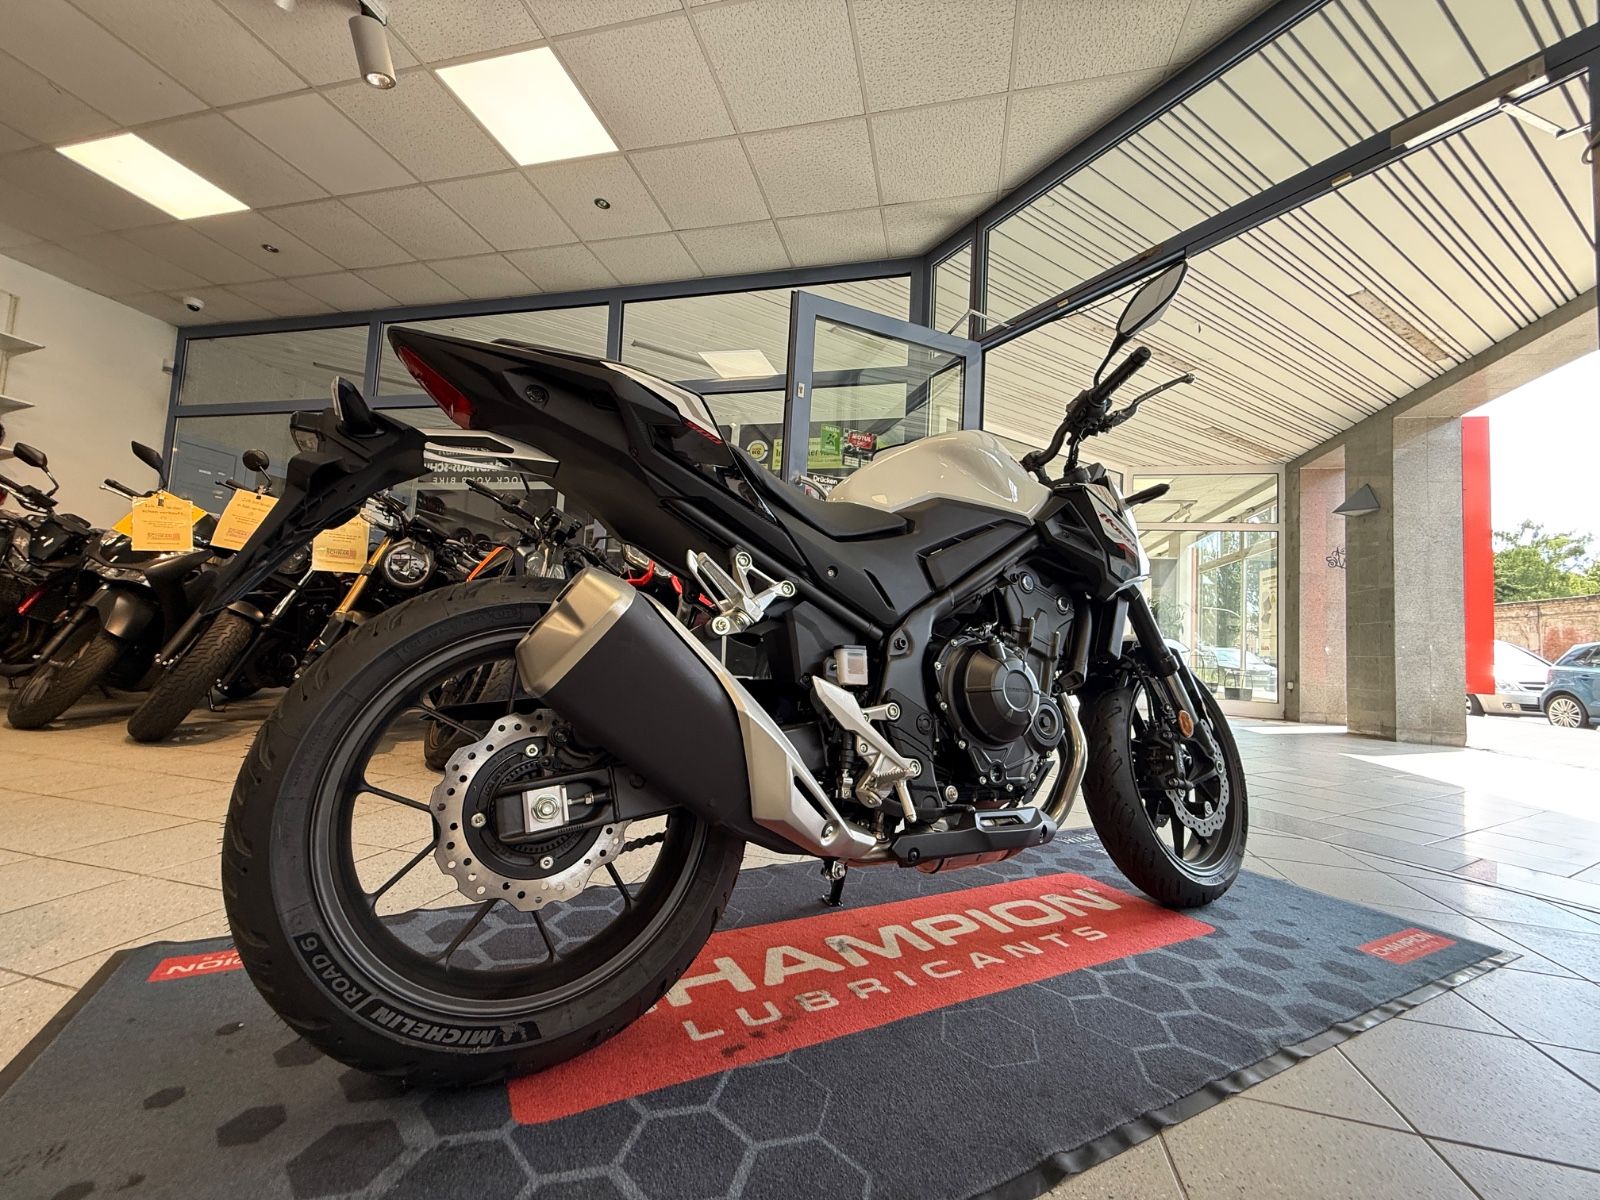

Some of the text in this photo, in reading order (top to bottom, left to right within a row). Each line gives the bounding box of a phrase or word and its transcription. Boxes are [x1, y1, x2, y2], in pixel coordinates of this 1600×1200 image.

[813, 475, 838, 485] Drücken
[300, 935, 364, 1005] ROAD 6
[645, 889, 1122, 1014] HAMPION
[1371, 932, 1435, 956] CHAMPION
[682, 926, 1109, 1042] LUBRICANTS
[370, 1006, 496, 1046] MICHELIN
